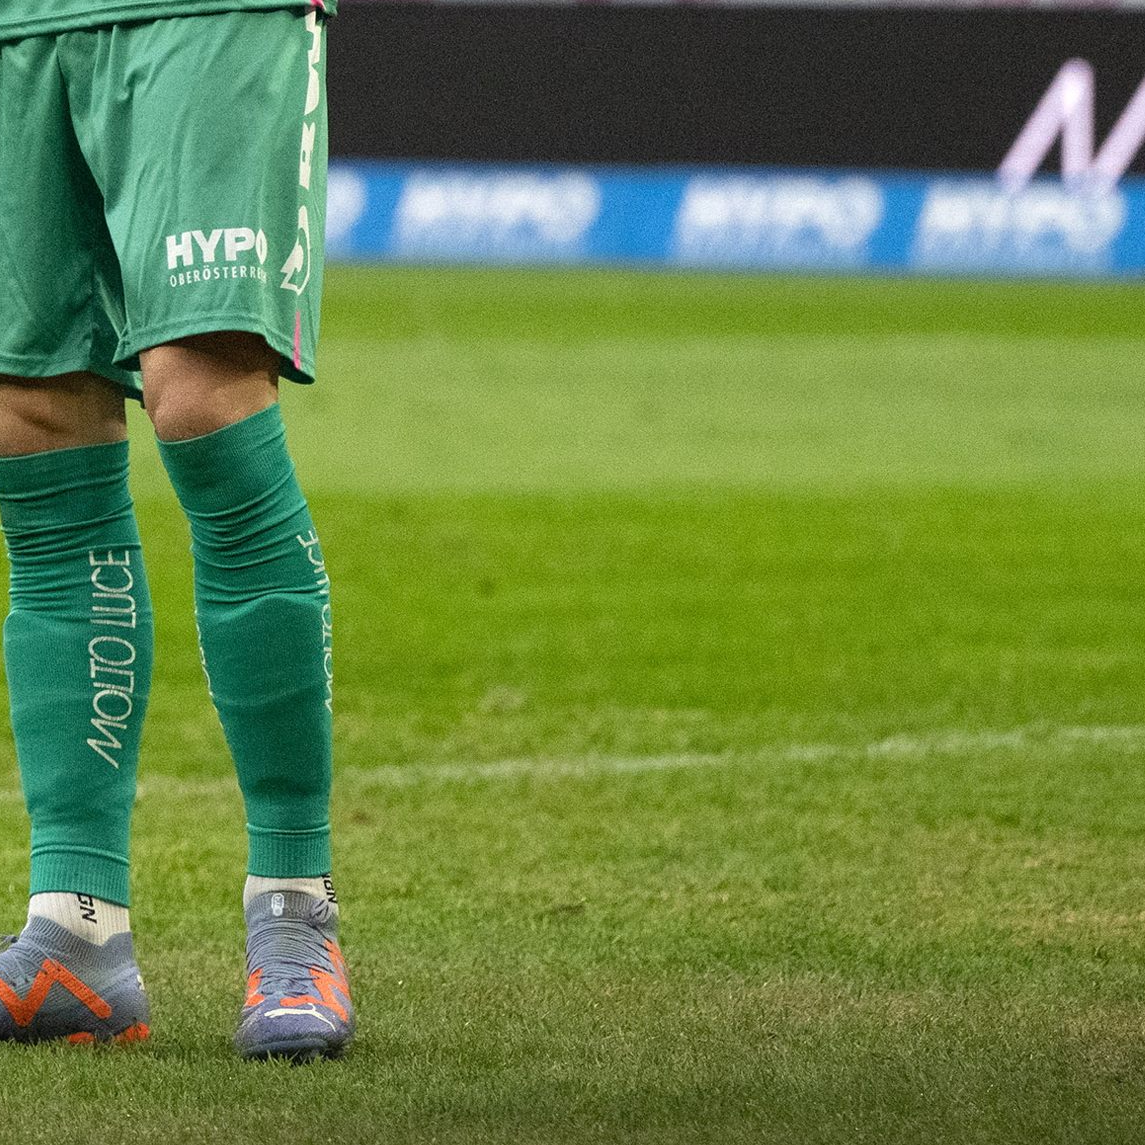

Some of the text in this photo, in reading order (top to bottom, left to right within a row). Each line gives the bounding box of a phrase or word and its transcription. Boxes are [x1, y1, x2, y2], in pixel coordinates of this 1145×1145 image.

[166, 227, 268, 269] HYPO
[87, 550, 137, 770] MOLTO LUCE
